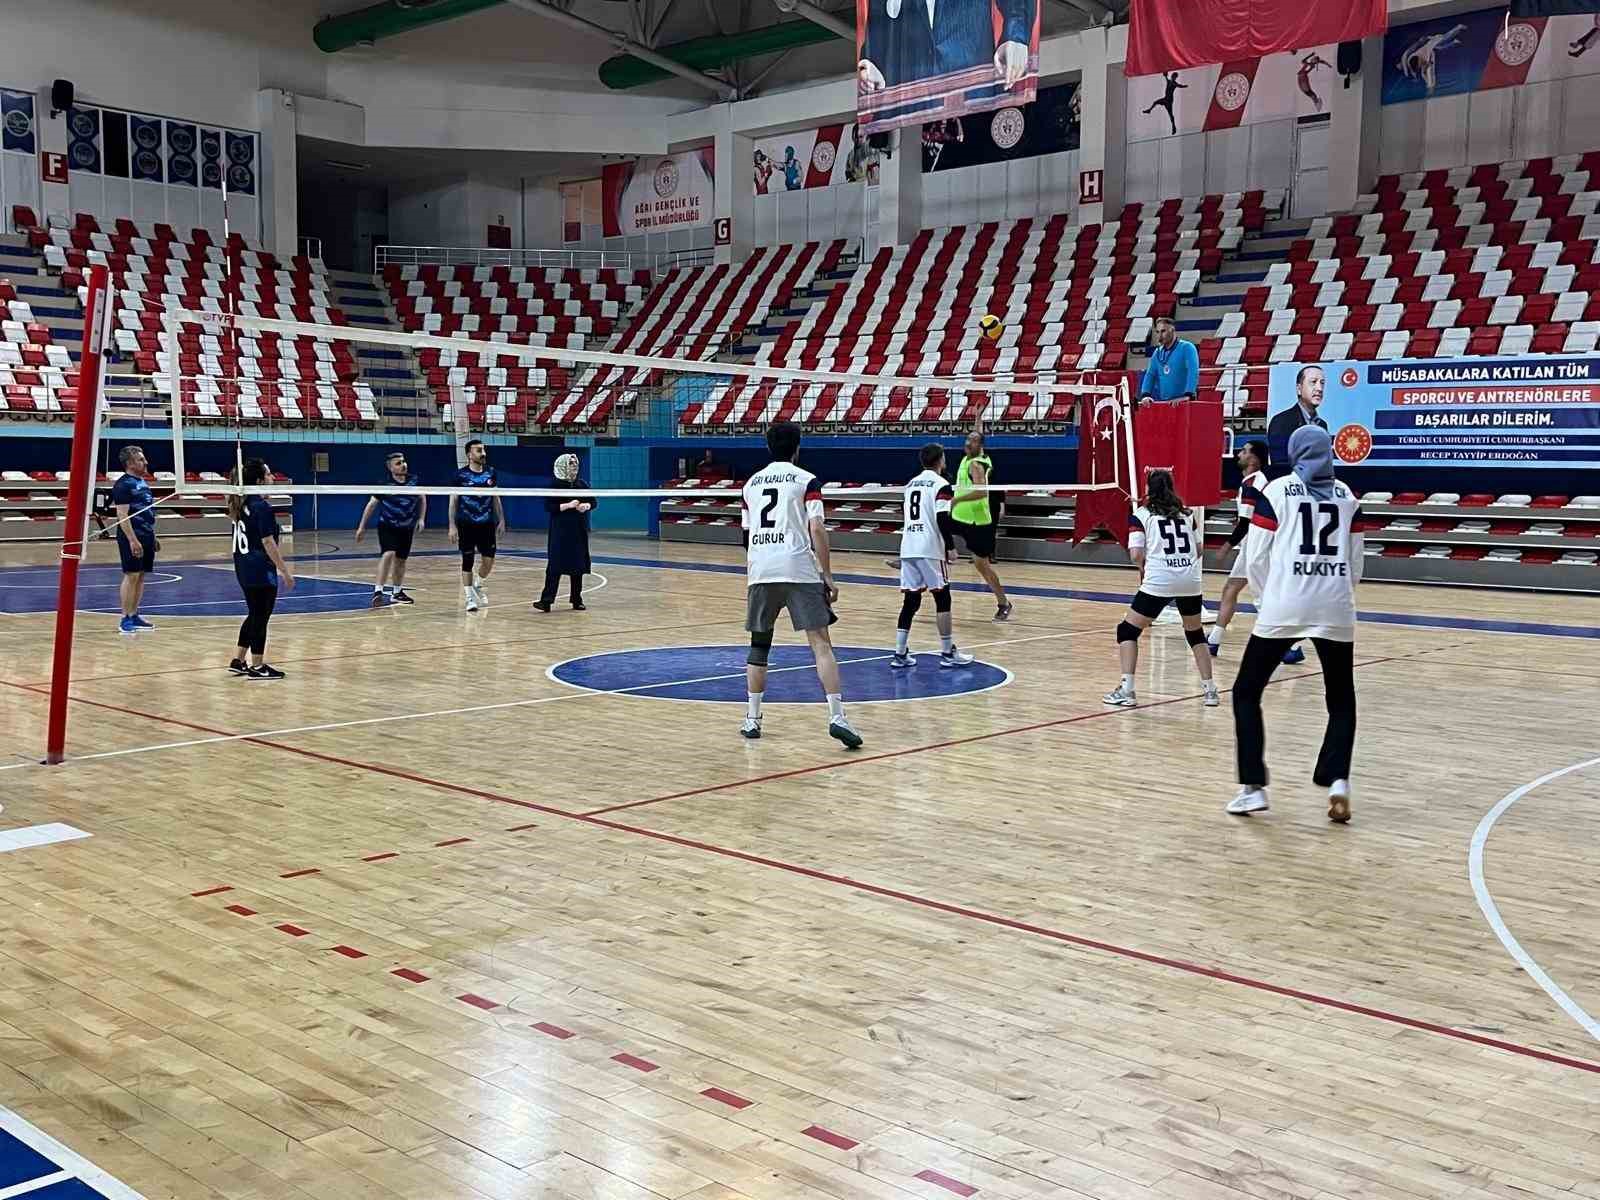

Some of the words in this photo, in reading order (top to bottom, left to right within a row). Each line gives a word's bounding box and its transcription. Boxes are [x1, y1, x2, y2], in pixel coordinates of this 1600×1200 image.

[48, 153, 61, 176] F
[1083, 171, 1099, 197] H
[655, 198, 687, 211] GENÇLİK
[689, 196, 700, 207] VE
[718, 219, 728, 239] G
[1382, 367, 1490, 382] MÜSABAKALARA
[1493, 366, 1554, 379] KATILAN
[1558, 362, 1589, 378] TÜM
[1403, 391, 1455, 404] SPORCU
[1457, 391, 1475, 404] VE
[1476, 387, 1592, 403] ANTRENÖRLERE
[1415, 413, 1490, 428] BAŞARILAR
[1493, 410, 1555, 426] DİLERİM.
[1398, 436, 1432, 444] TÜRKİYE
[1491, 436, 1565, 444] CUMHURBAŞKANI
[1420, 451, 1451, 459] RECEP
[1452, 451, 1487, 459] TAYYİP
[1488, 451, 1538, 460] ERDOĞAN
[761, 488, 779, 528] 2
[910, 490, 921, 521] 8
[752, 532, 785, 545] GURUR
[1158, 518, 1190, 555] 55
[1298, 502, 1339, 556] 12
[1293, 558, 1347, 577] RUKİYE
